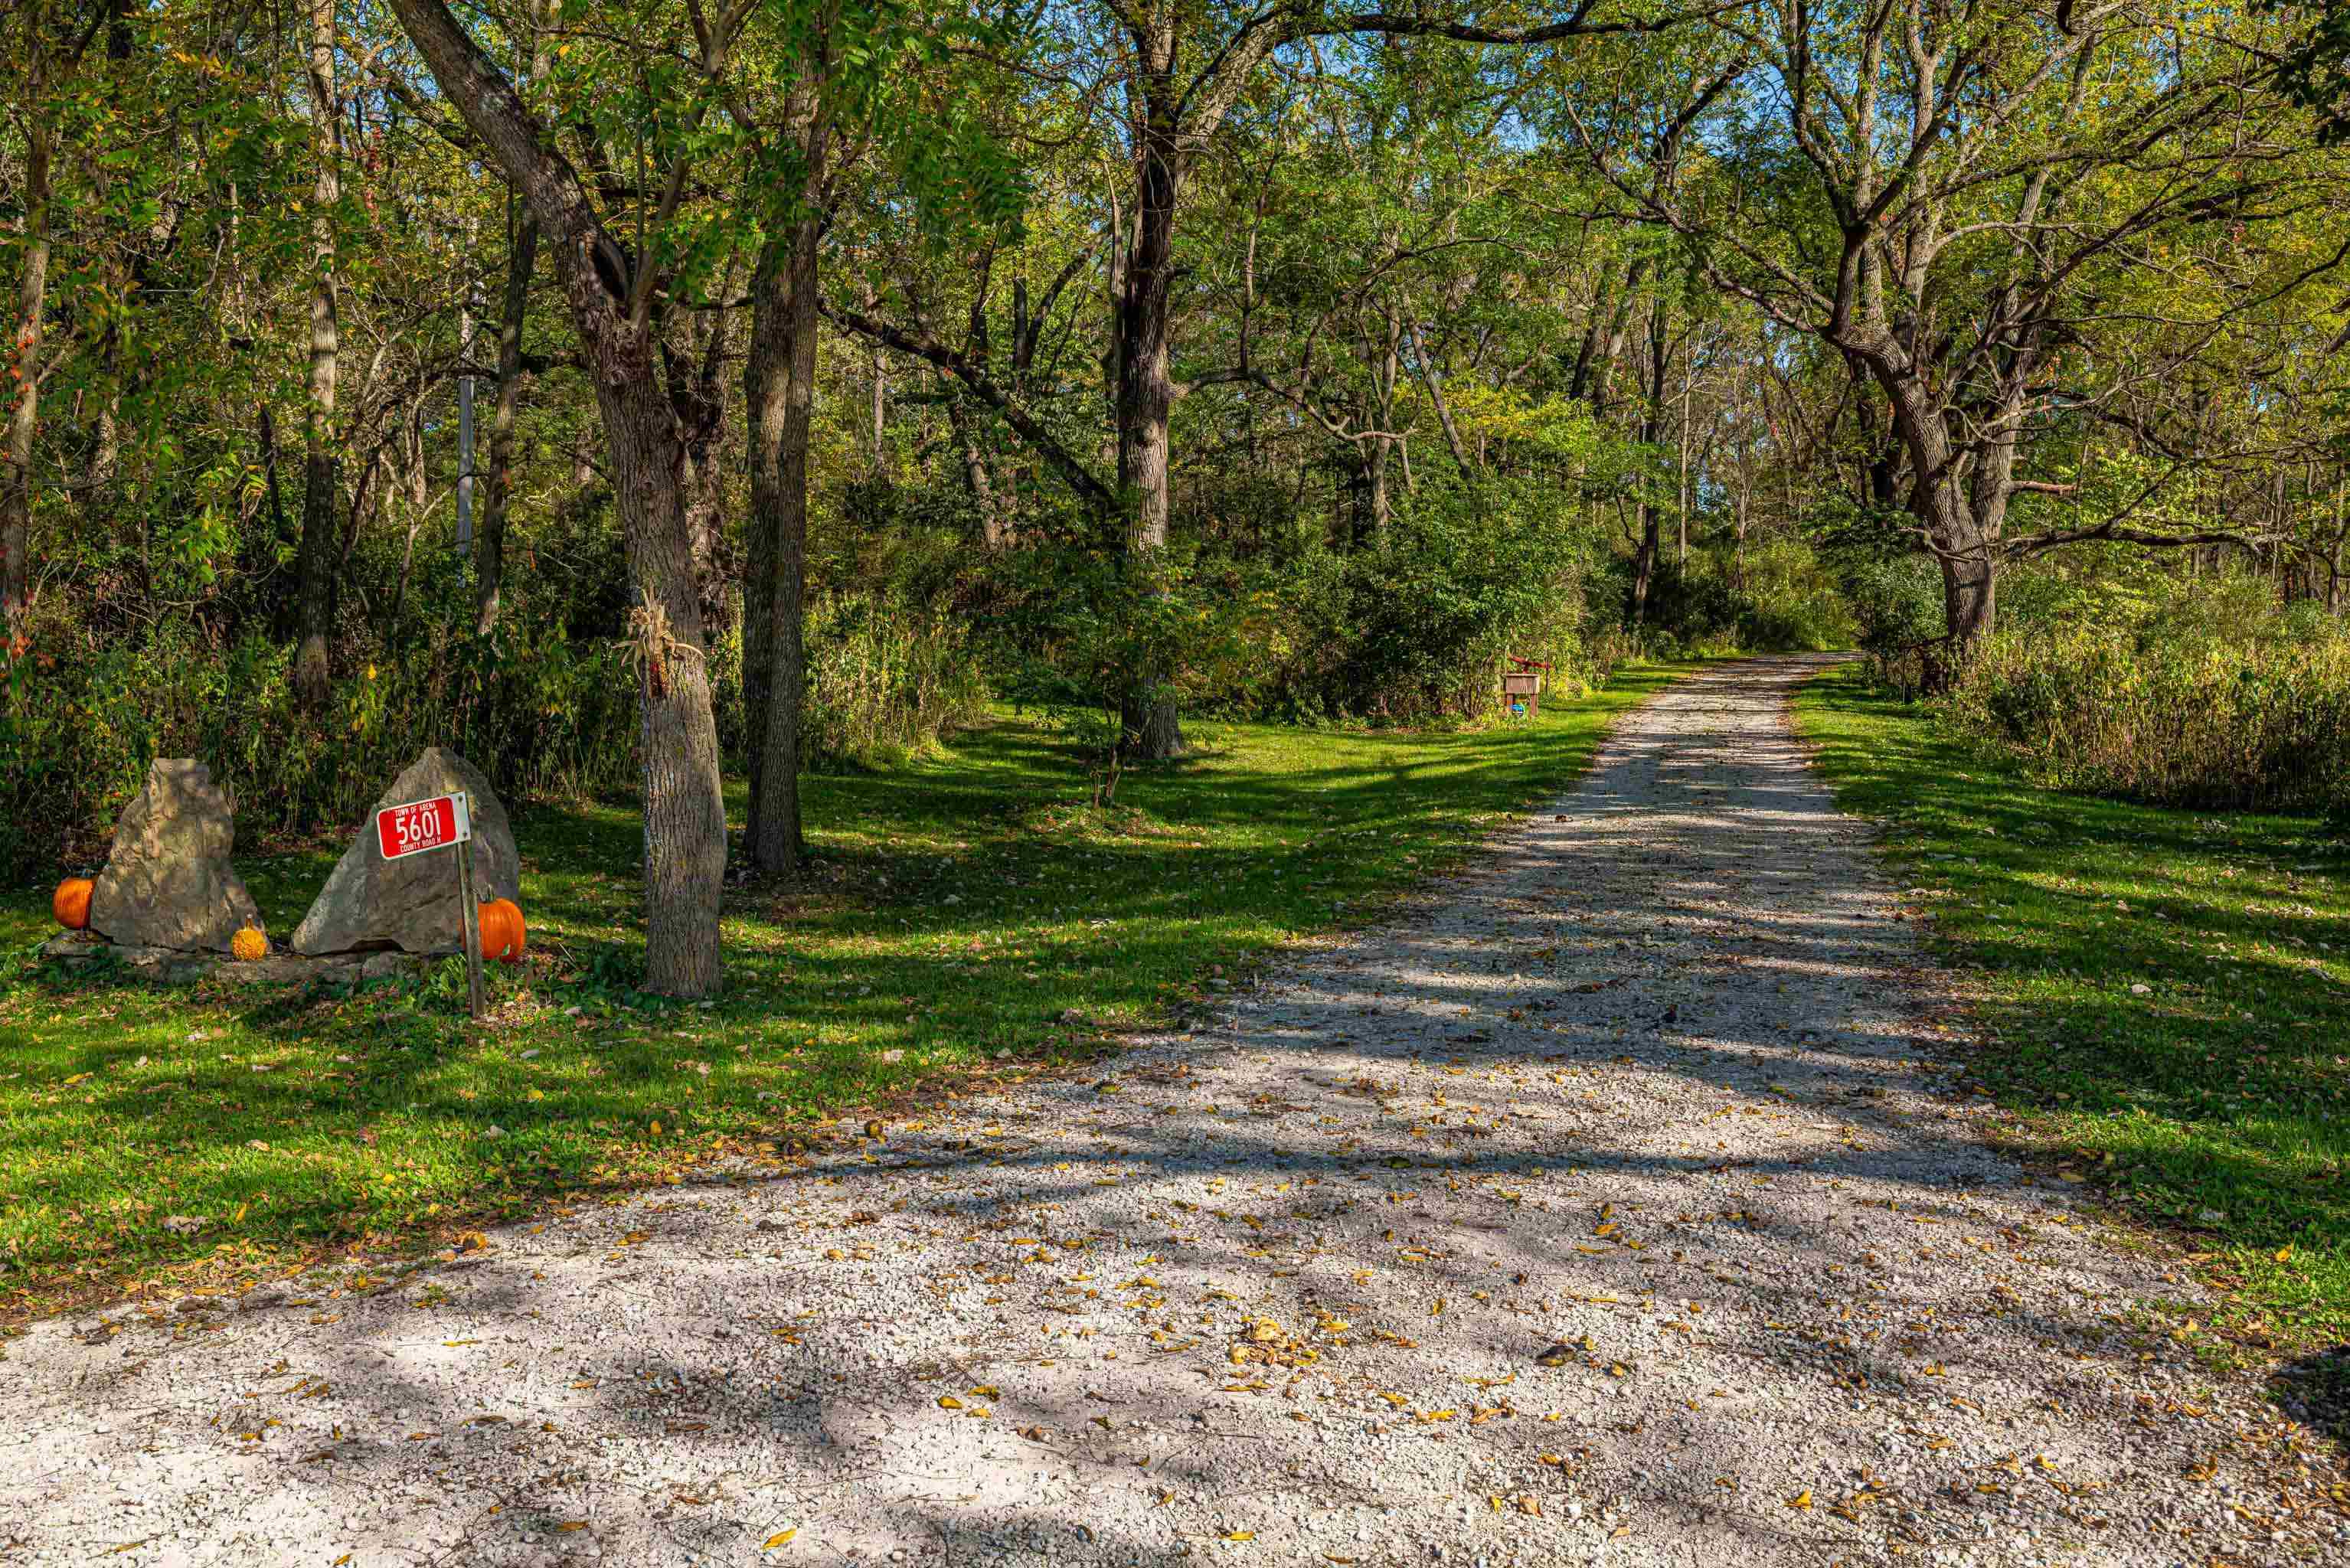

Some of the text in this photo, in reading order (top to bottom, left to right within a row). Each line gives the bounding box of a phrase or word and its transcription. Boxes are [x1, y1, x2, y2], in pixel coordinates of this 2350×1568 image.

[394, 802, 436, 817] TOWN OF ARENA
[396, 809, 441, 845] 5601
[400, 842, 420, 853] COUNTY
[423, 838, 436, 847] ROAD
